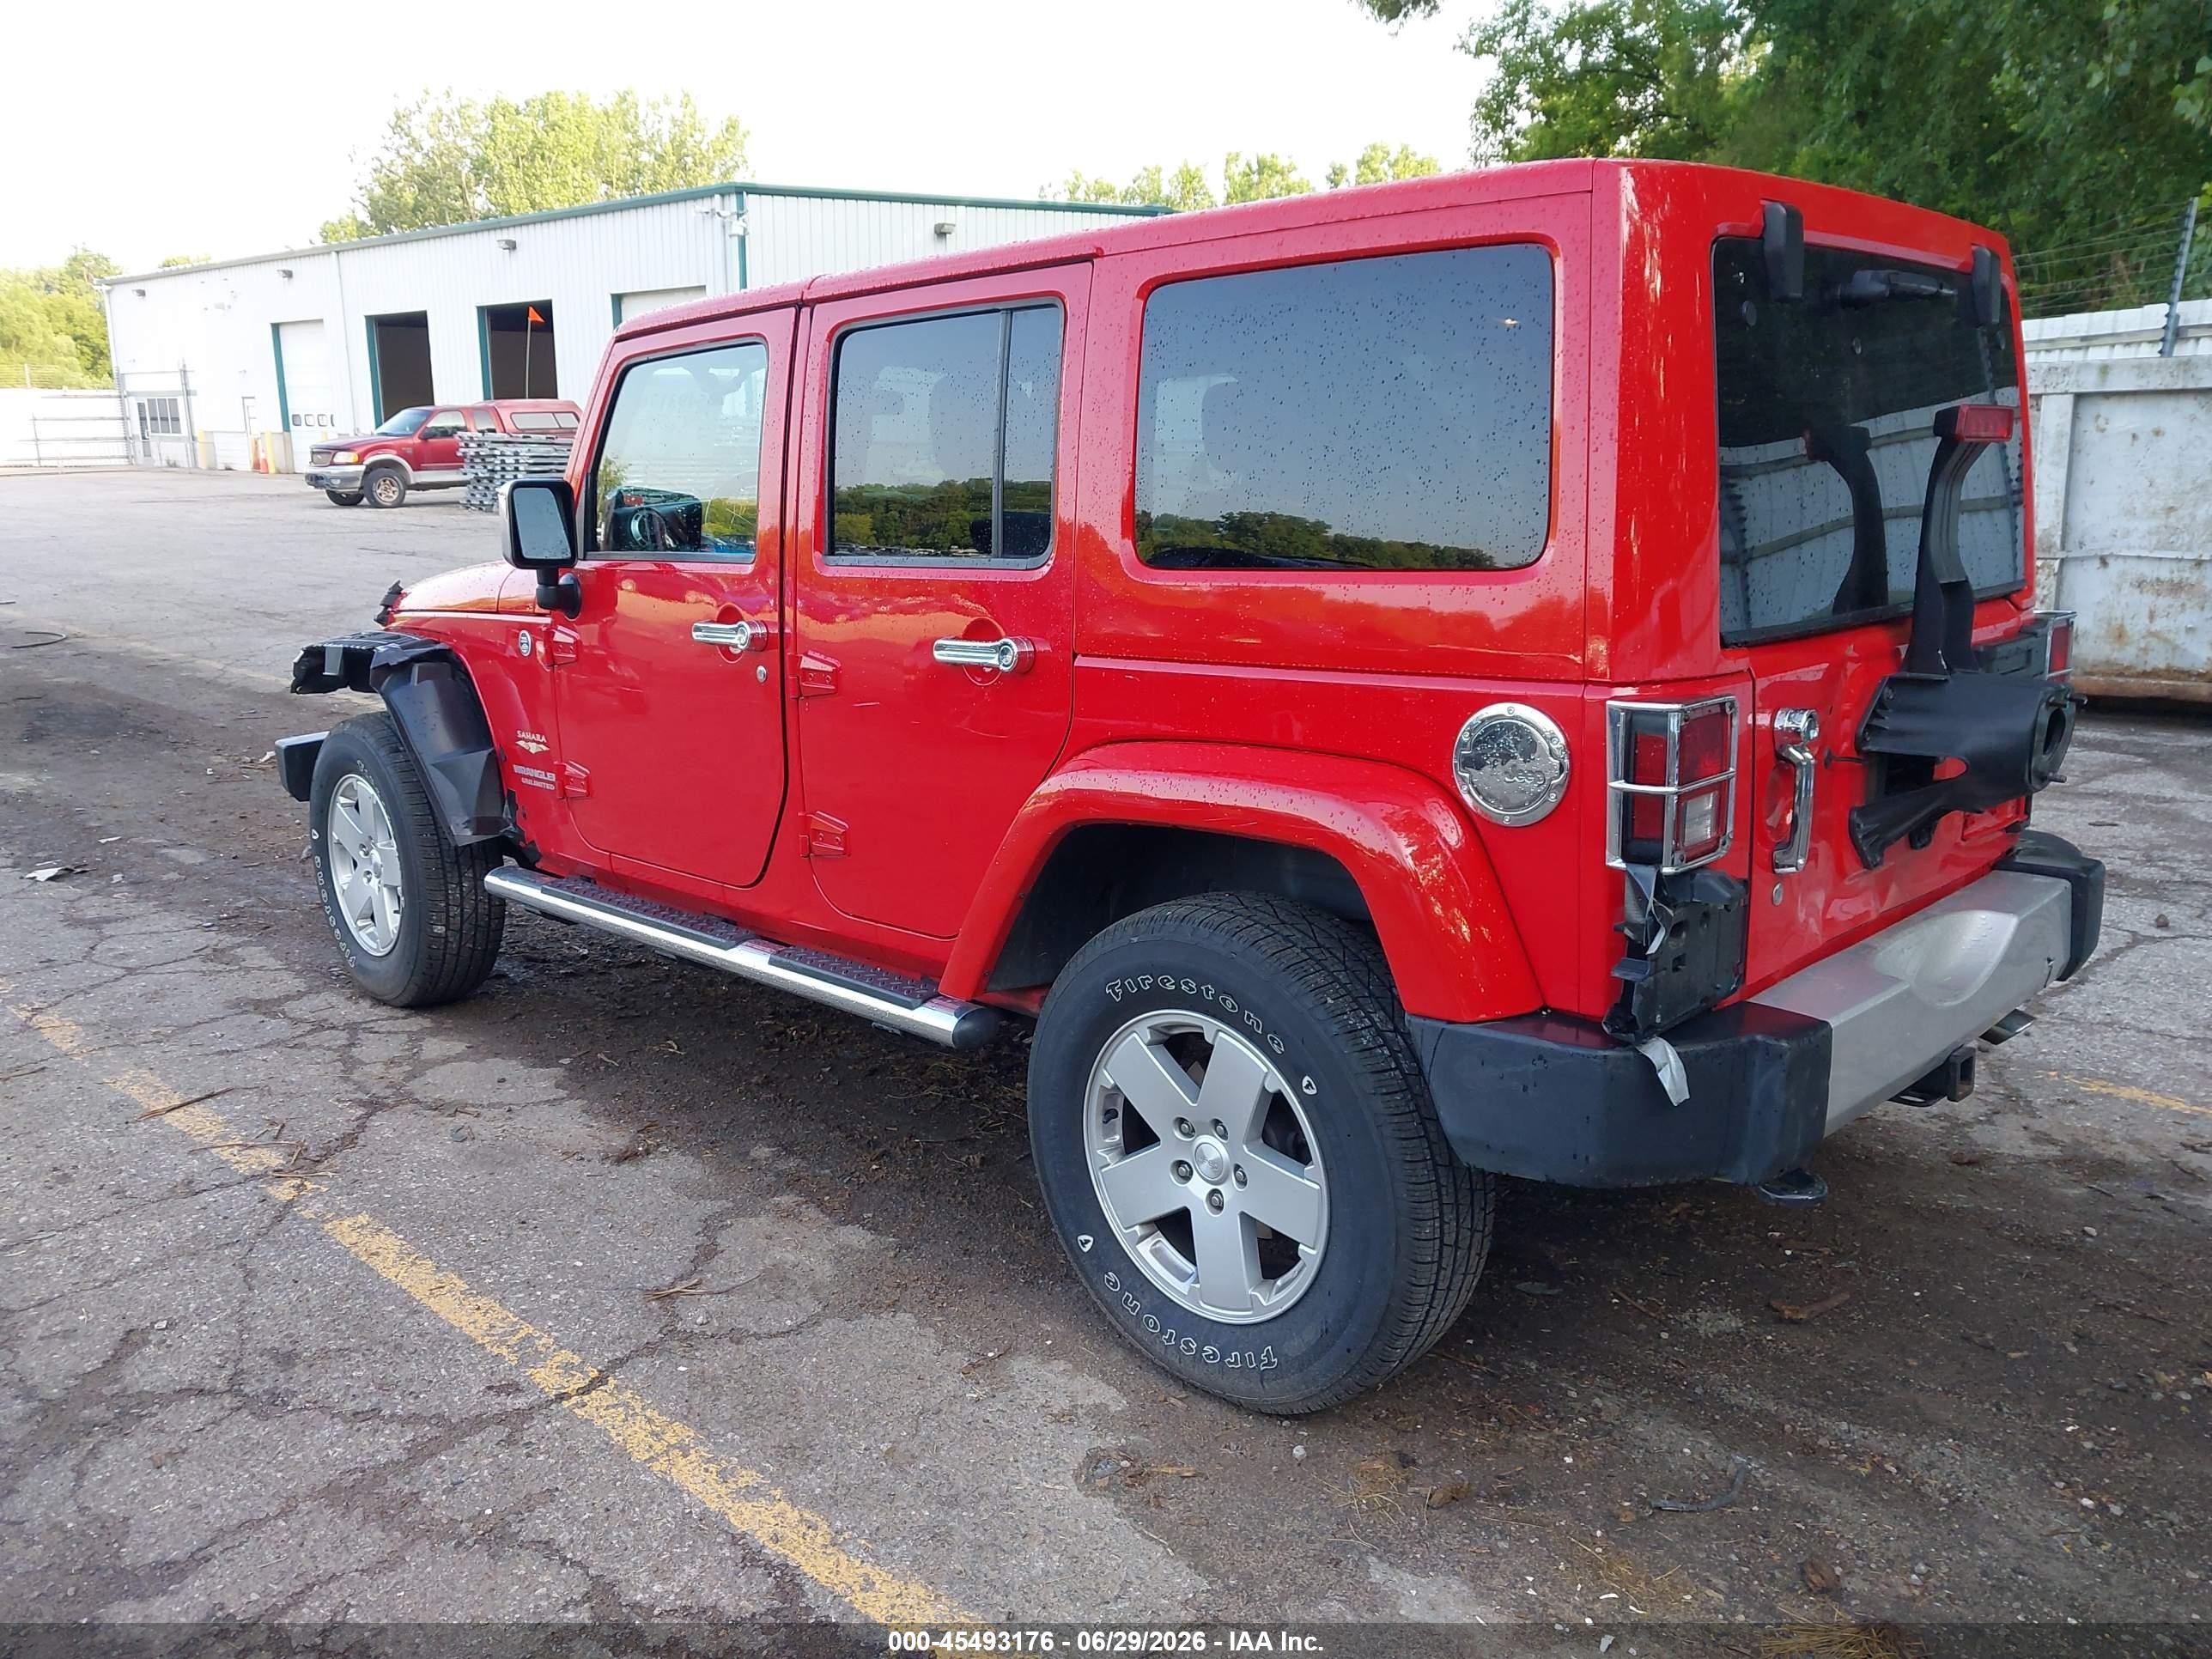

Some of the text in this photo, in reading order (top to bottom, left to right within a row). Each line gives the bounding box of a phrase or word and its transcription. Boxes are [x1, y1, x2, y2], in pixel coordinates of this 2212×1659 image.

[516, 730, 547, 743] SAHARA
[1106, 975, 1285, 1054] Firestone
[1104, 1271, 1278, 1370] Firestone
